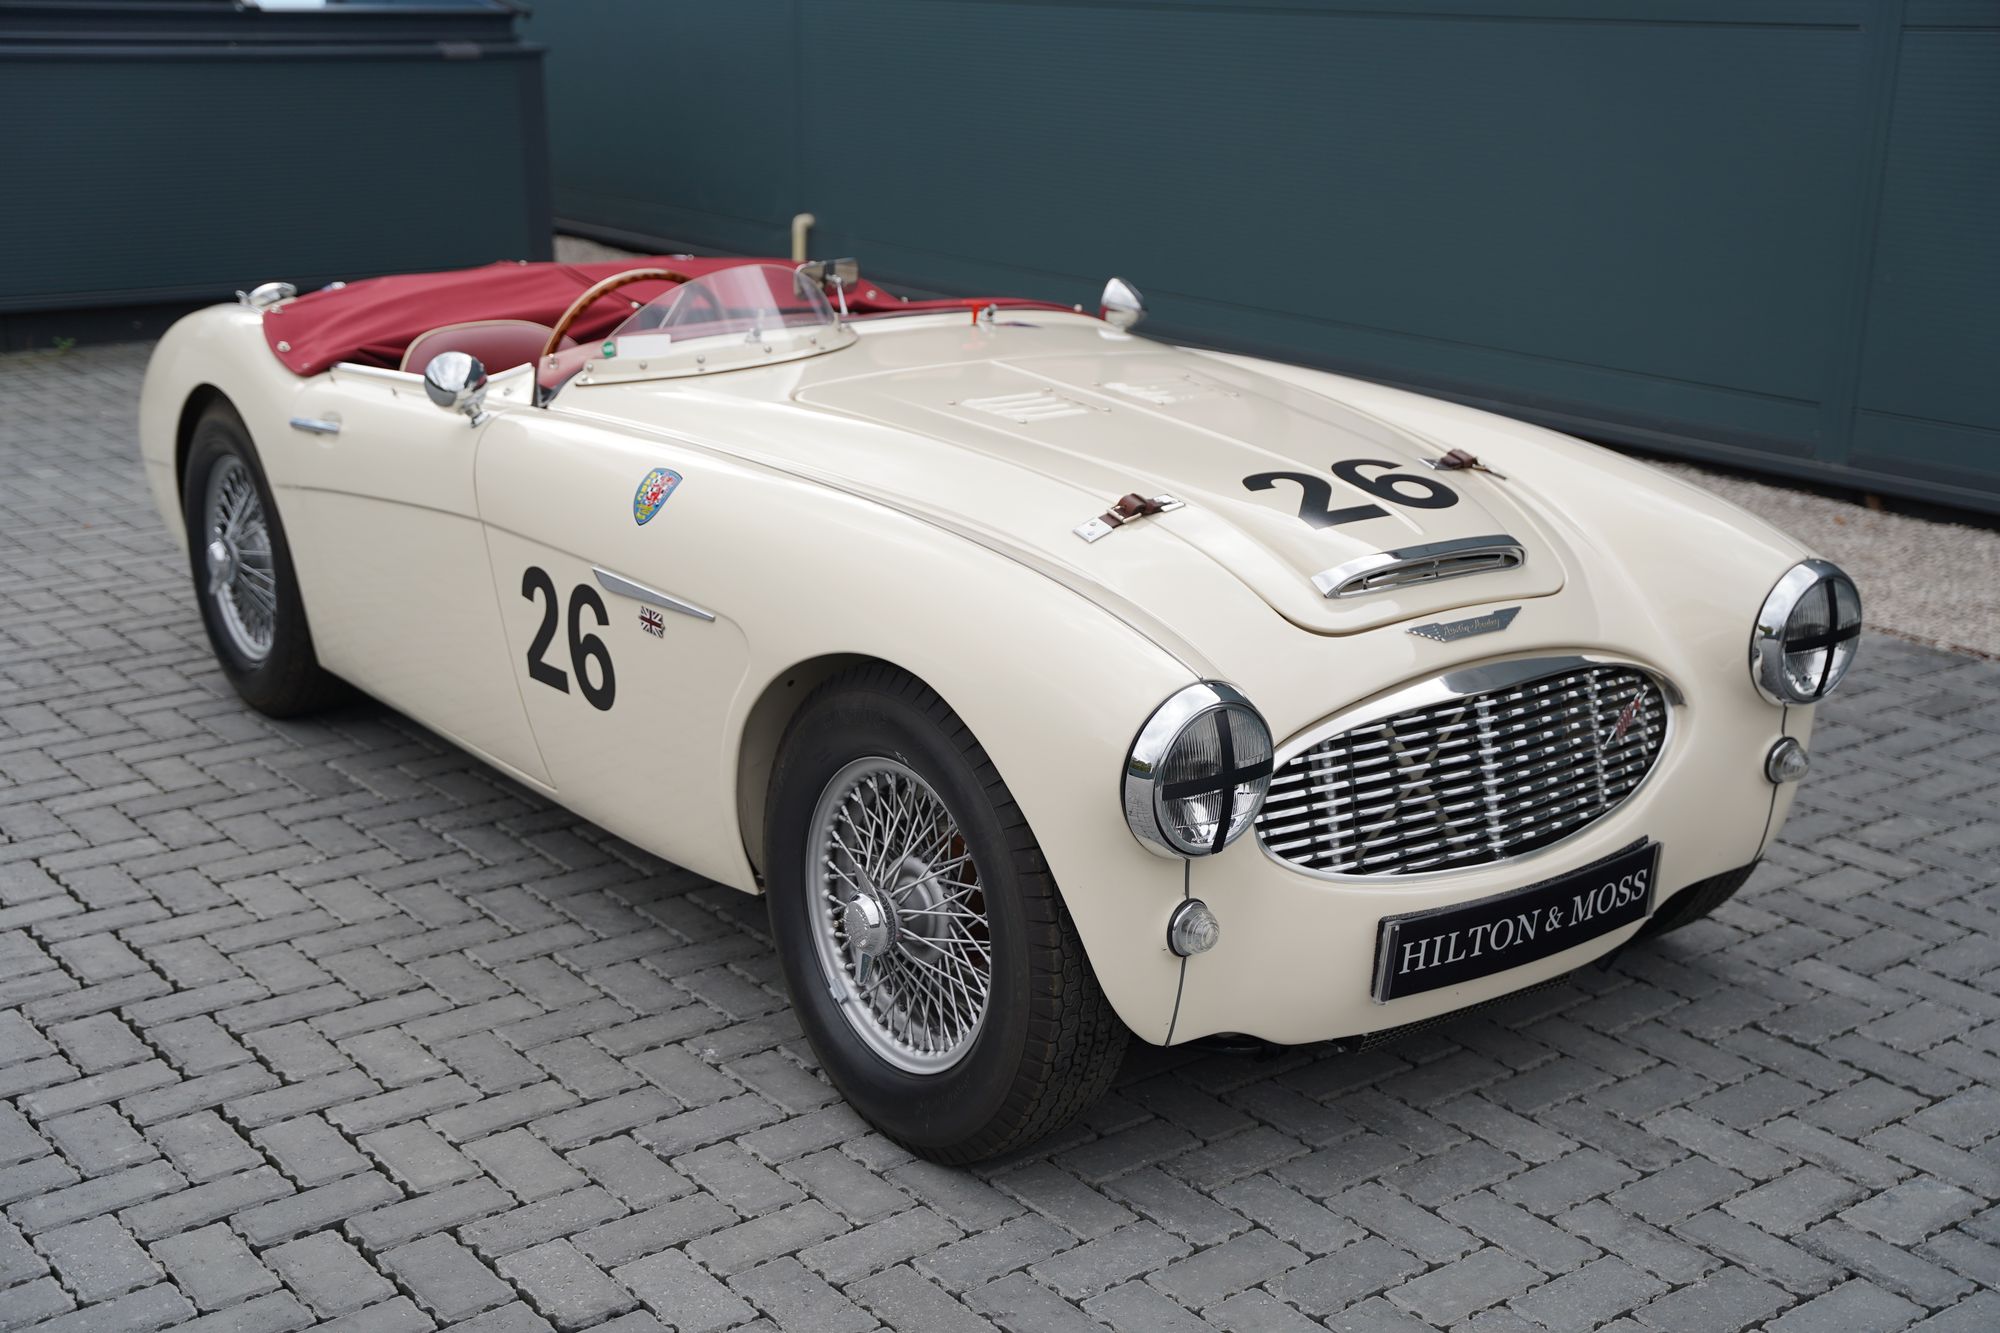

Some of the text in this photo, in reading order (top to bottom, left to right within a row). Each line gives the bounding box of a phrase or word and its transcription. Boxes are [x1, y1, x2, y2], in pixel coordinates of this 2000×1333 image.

[1242, 458, 1459, 530] 26
[521, 566, 616, 712] 26
[1398, 868, 1648, 975] HILTON & MOSS
